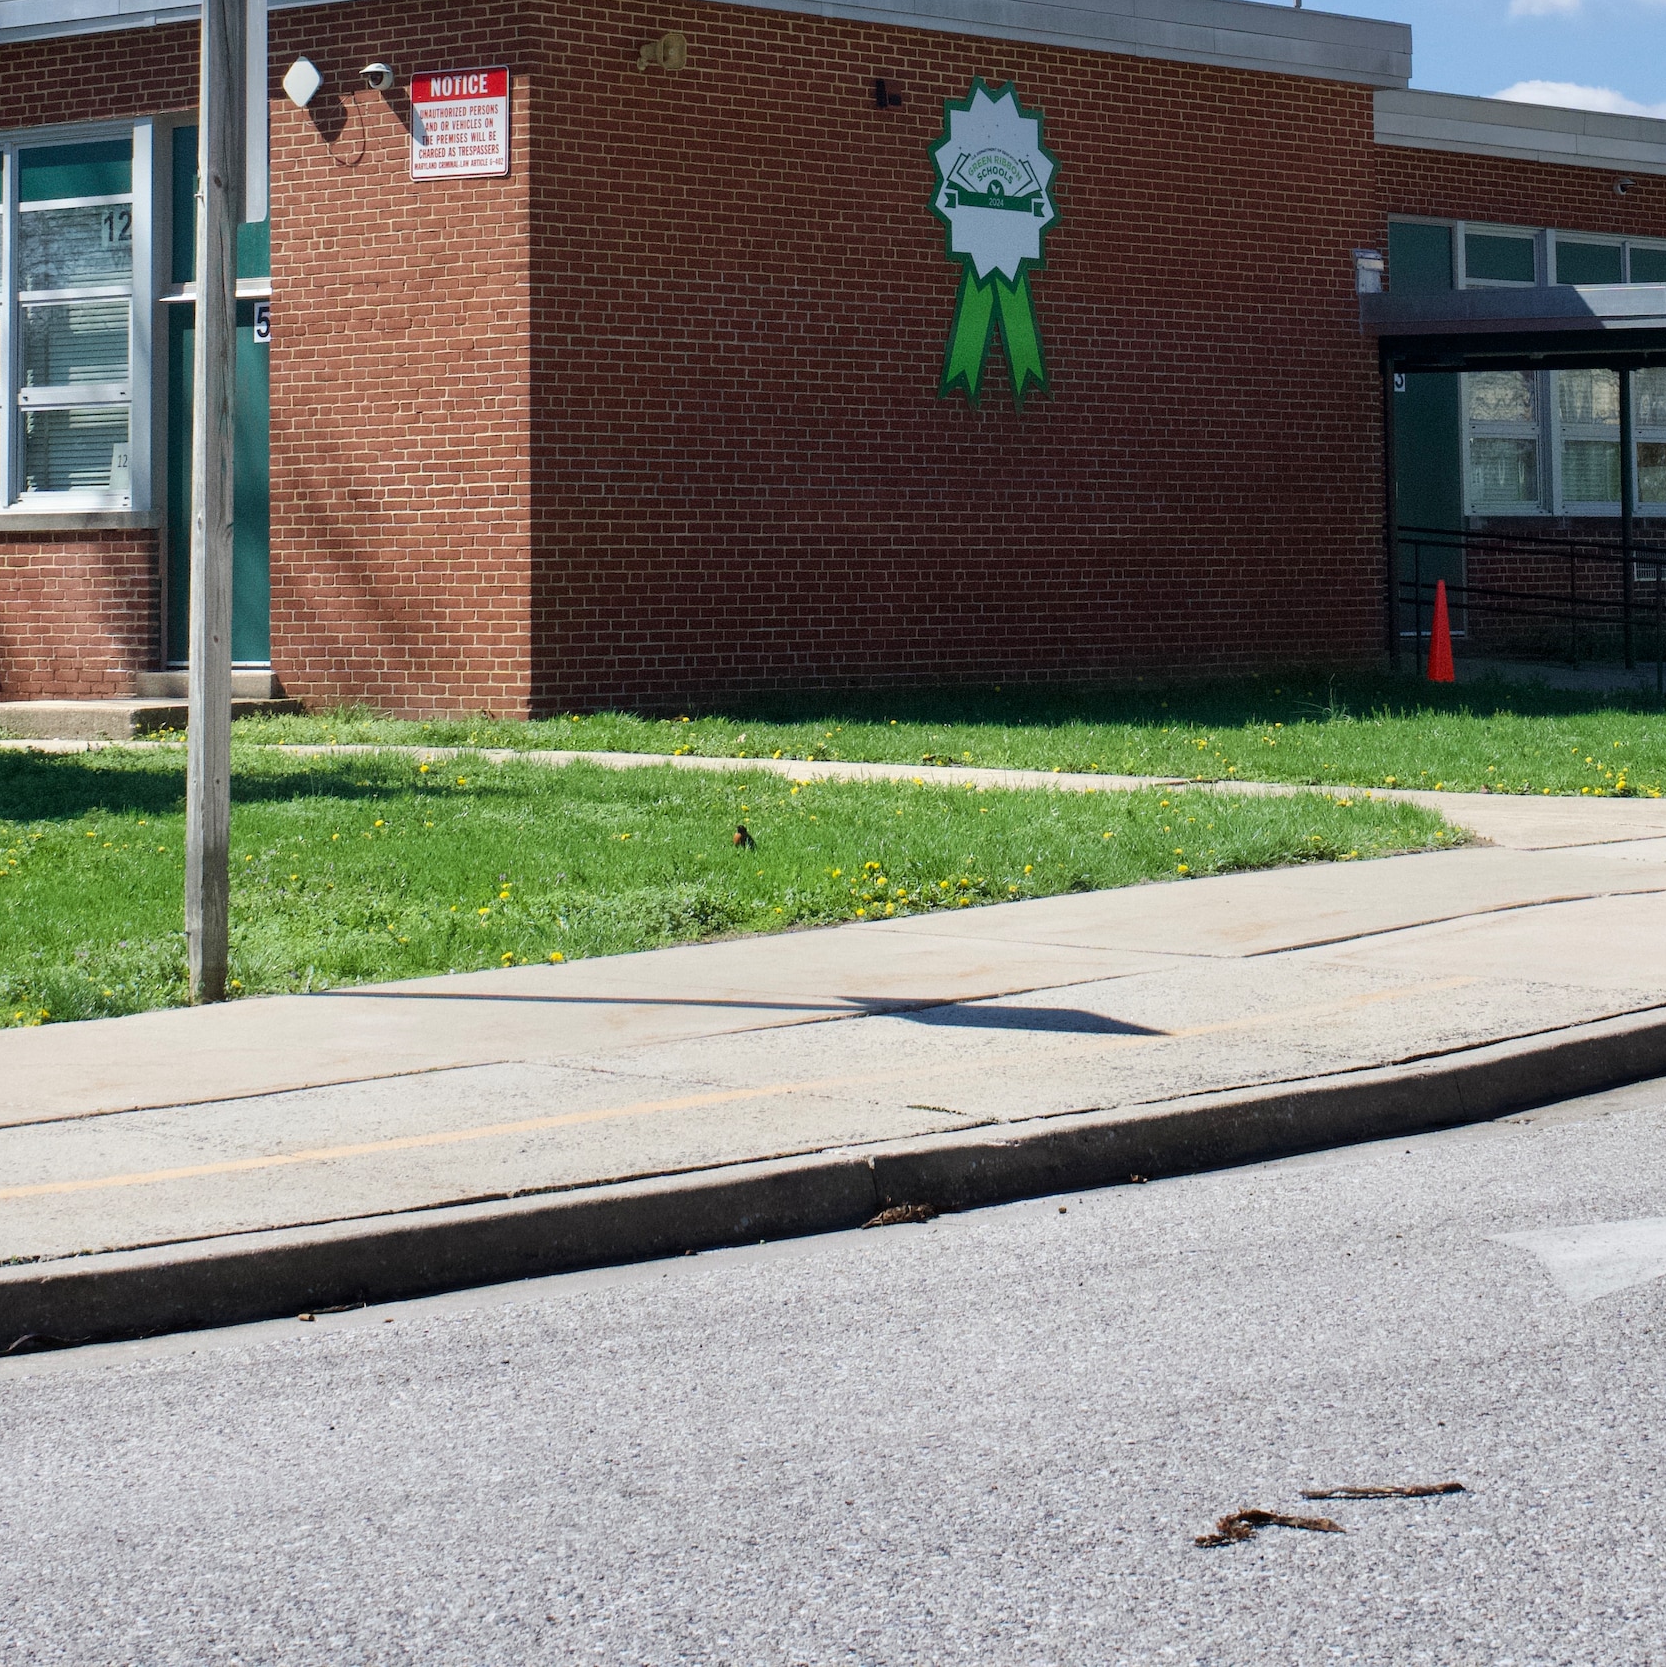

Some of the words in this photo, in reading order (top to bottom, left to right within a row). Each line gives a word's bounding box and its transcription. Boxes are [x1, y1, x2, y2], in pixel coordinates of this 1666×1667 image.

[430, 73, 488, 97] NOTICE
[419, 106, 467, 119] UNAUTHORIZED
[469, 104, 499, 116] PERSONS
[425, 121, 438, 132] AND
[440, 120, 450, 131] OR
[452, 118, 482, 130] VEHICLES
[484, 117, 494, 128] ON
[422, 135, 433, 146] THE
[436, 133, 468, 145] PREMISES
[471, 132, 486, 142] WILL
[488, 130, 497, 141] BE
[418, 147, 445, 159] CHARGED
[448, 146, 456, 157] AS
[458, 144, 499, 156] TRESPASSERS
[414, 161, 437, 170] MARYLAND
[471, 158, 488, 167] ARTICLE
[968, 155, 992, 176] GREEN
[994, 156, 1023, 181] RIBBON
[976, 166, 1013, 184] SCHOOLS
[988, 197, 1004, 207] 2024
[104, 211, 132, 241] 12
[256, 306, 271, 338] 5
[117, 454, 128, 467] 12
